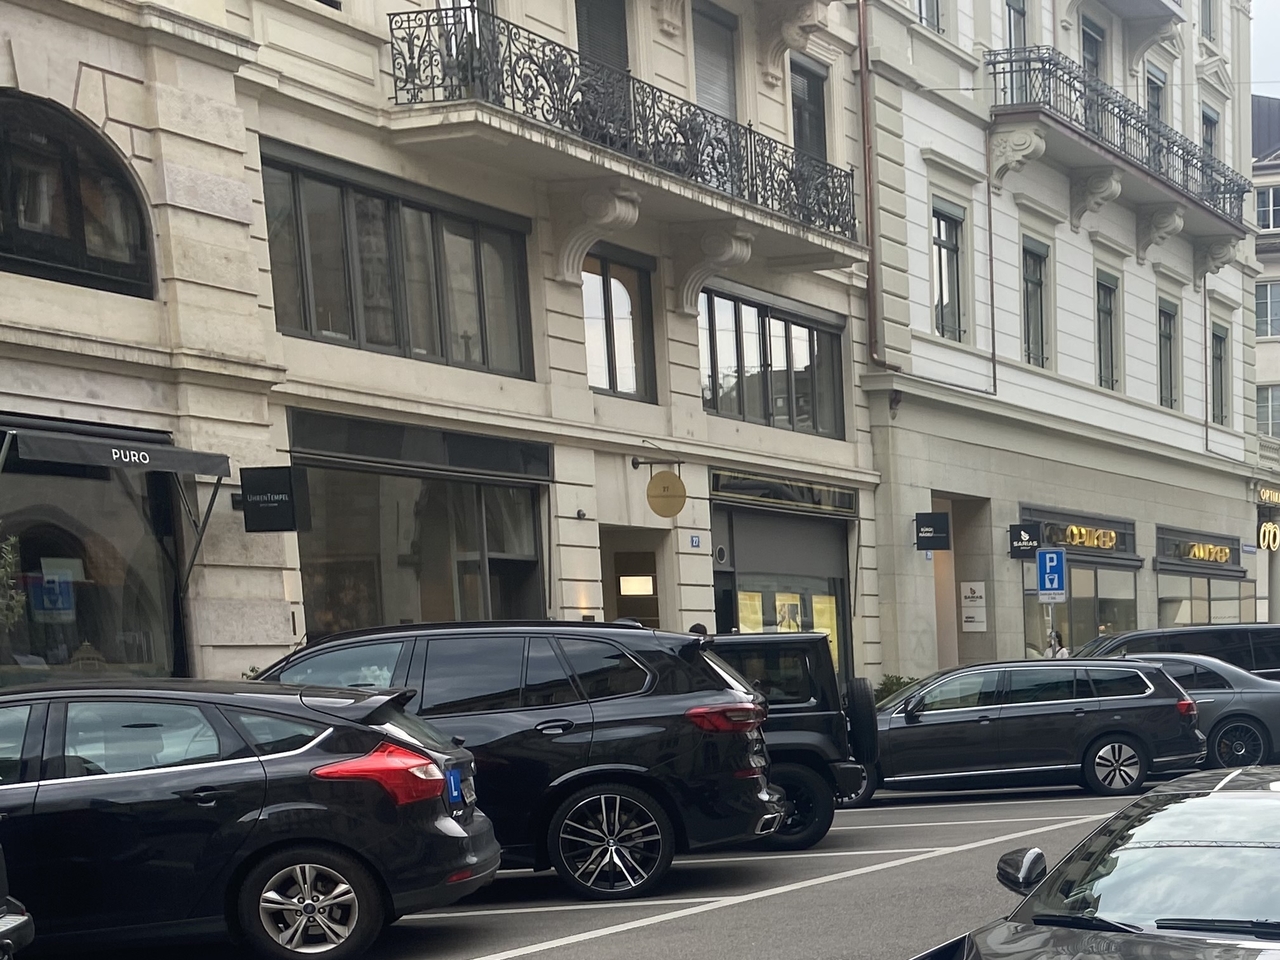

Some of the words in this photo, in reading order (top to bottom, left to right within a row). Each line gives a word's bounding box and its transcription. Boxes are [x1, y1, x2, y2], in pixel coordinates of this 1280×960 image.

[112, 448, 150, 464] PURO
[692, 537, 698, 546] 27
[1046, 553, 1057, 574] P
